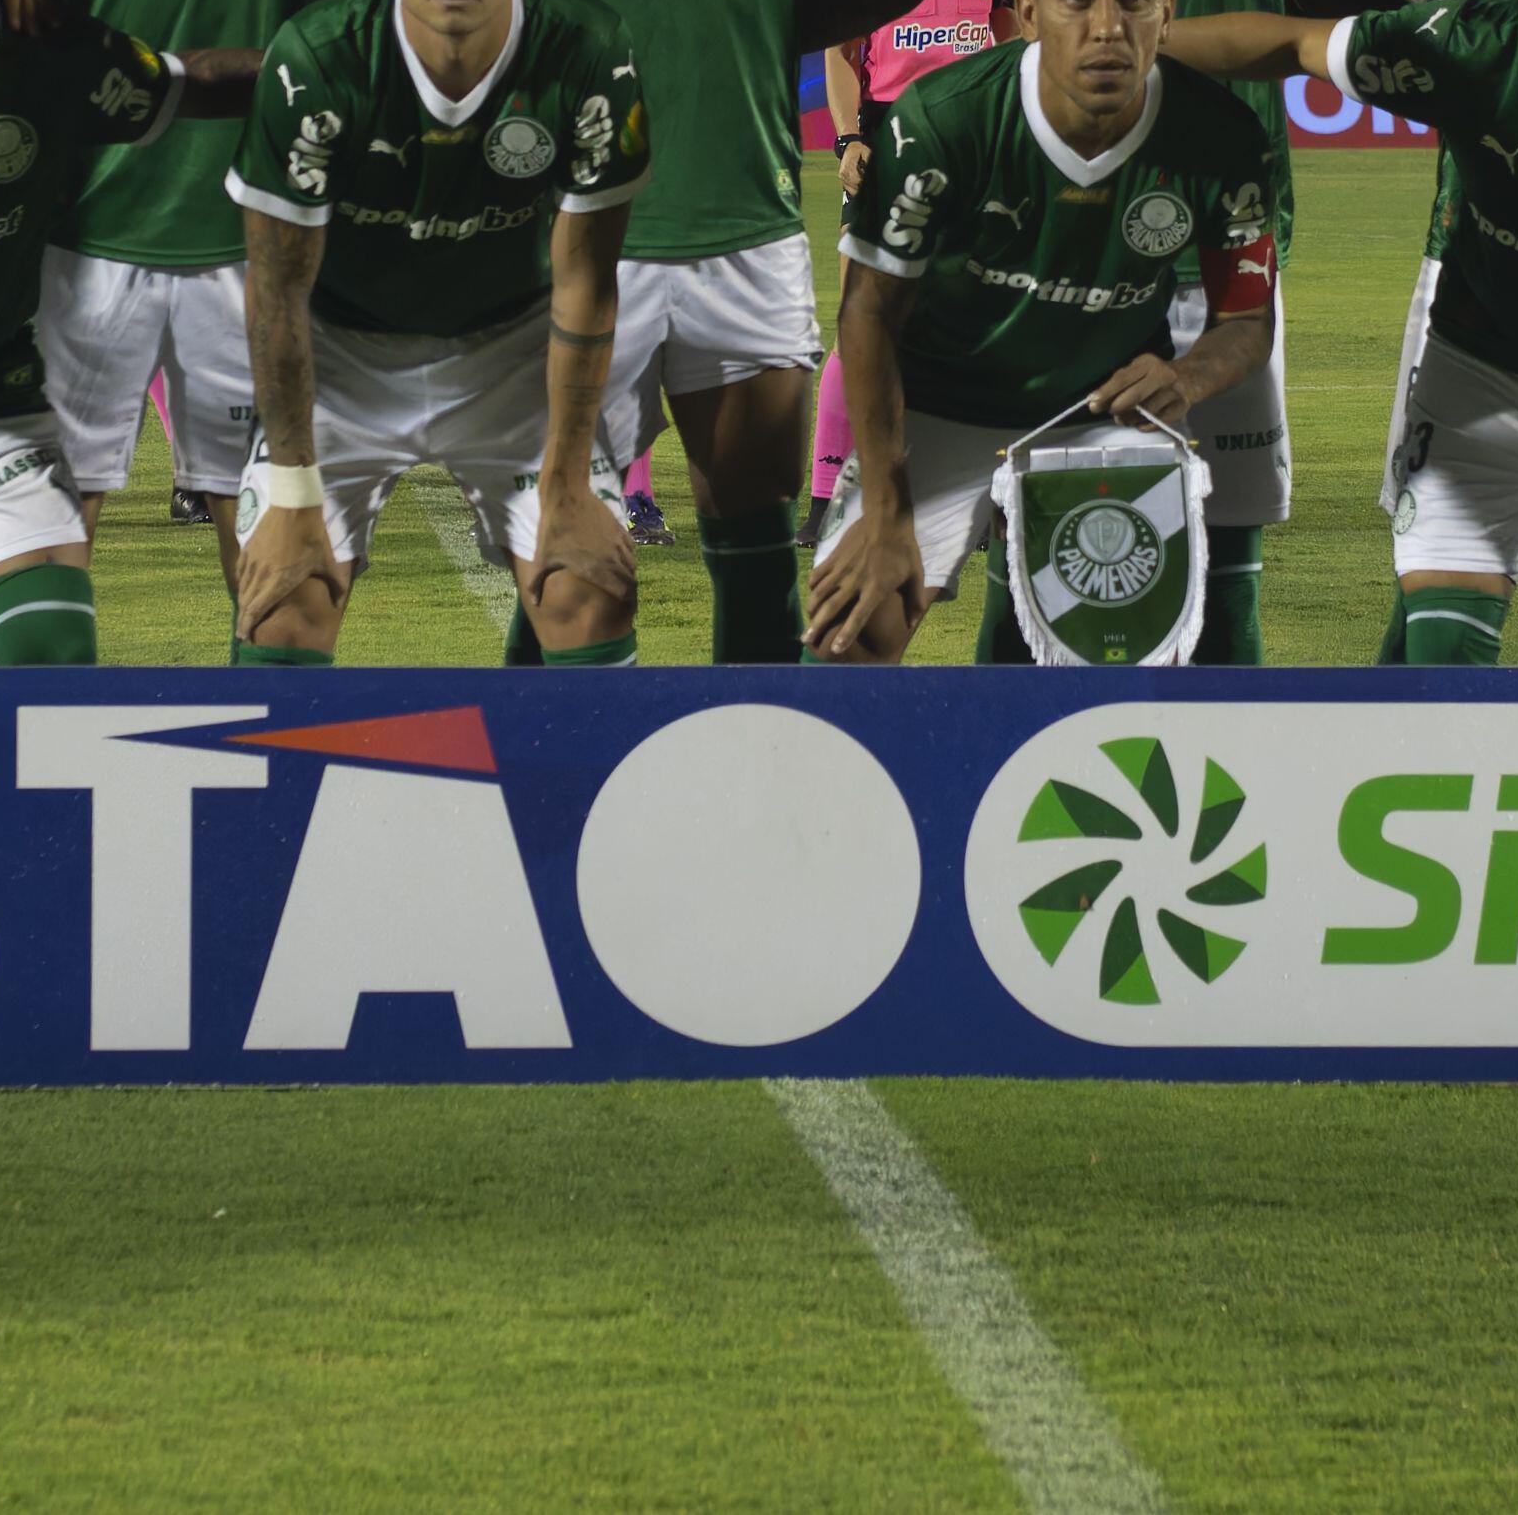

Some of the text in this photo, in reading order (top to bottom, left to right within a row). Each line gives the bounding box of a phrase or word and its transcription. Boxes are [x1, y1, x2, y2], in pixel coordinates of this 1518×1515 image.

[894, 19, 989, 52] HiperCap
[1128, 219, 1187, 253] PALMEIRAS
[1056, 545, 1159, 601] PALMEIRAS
